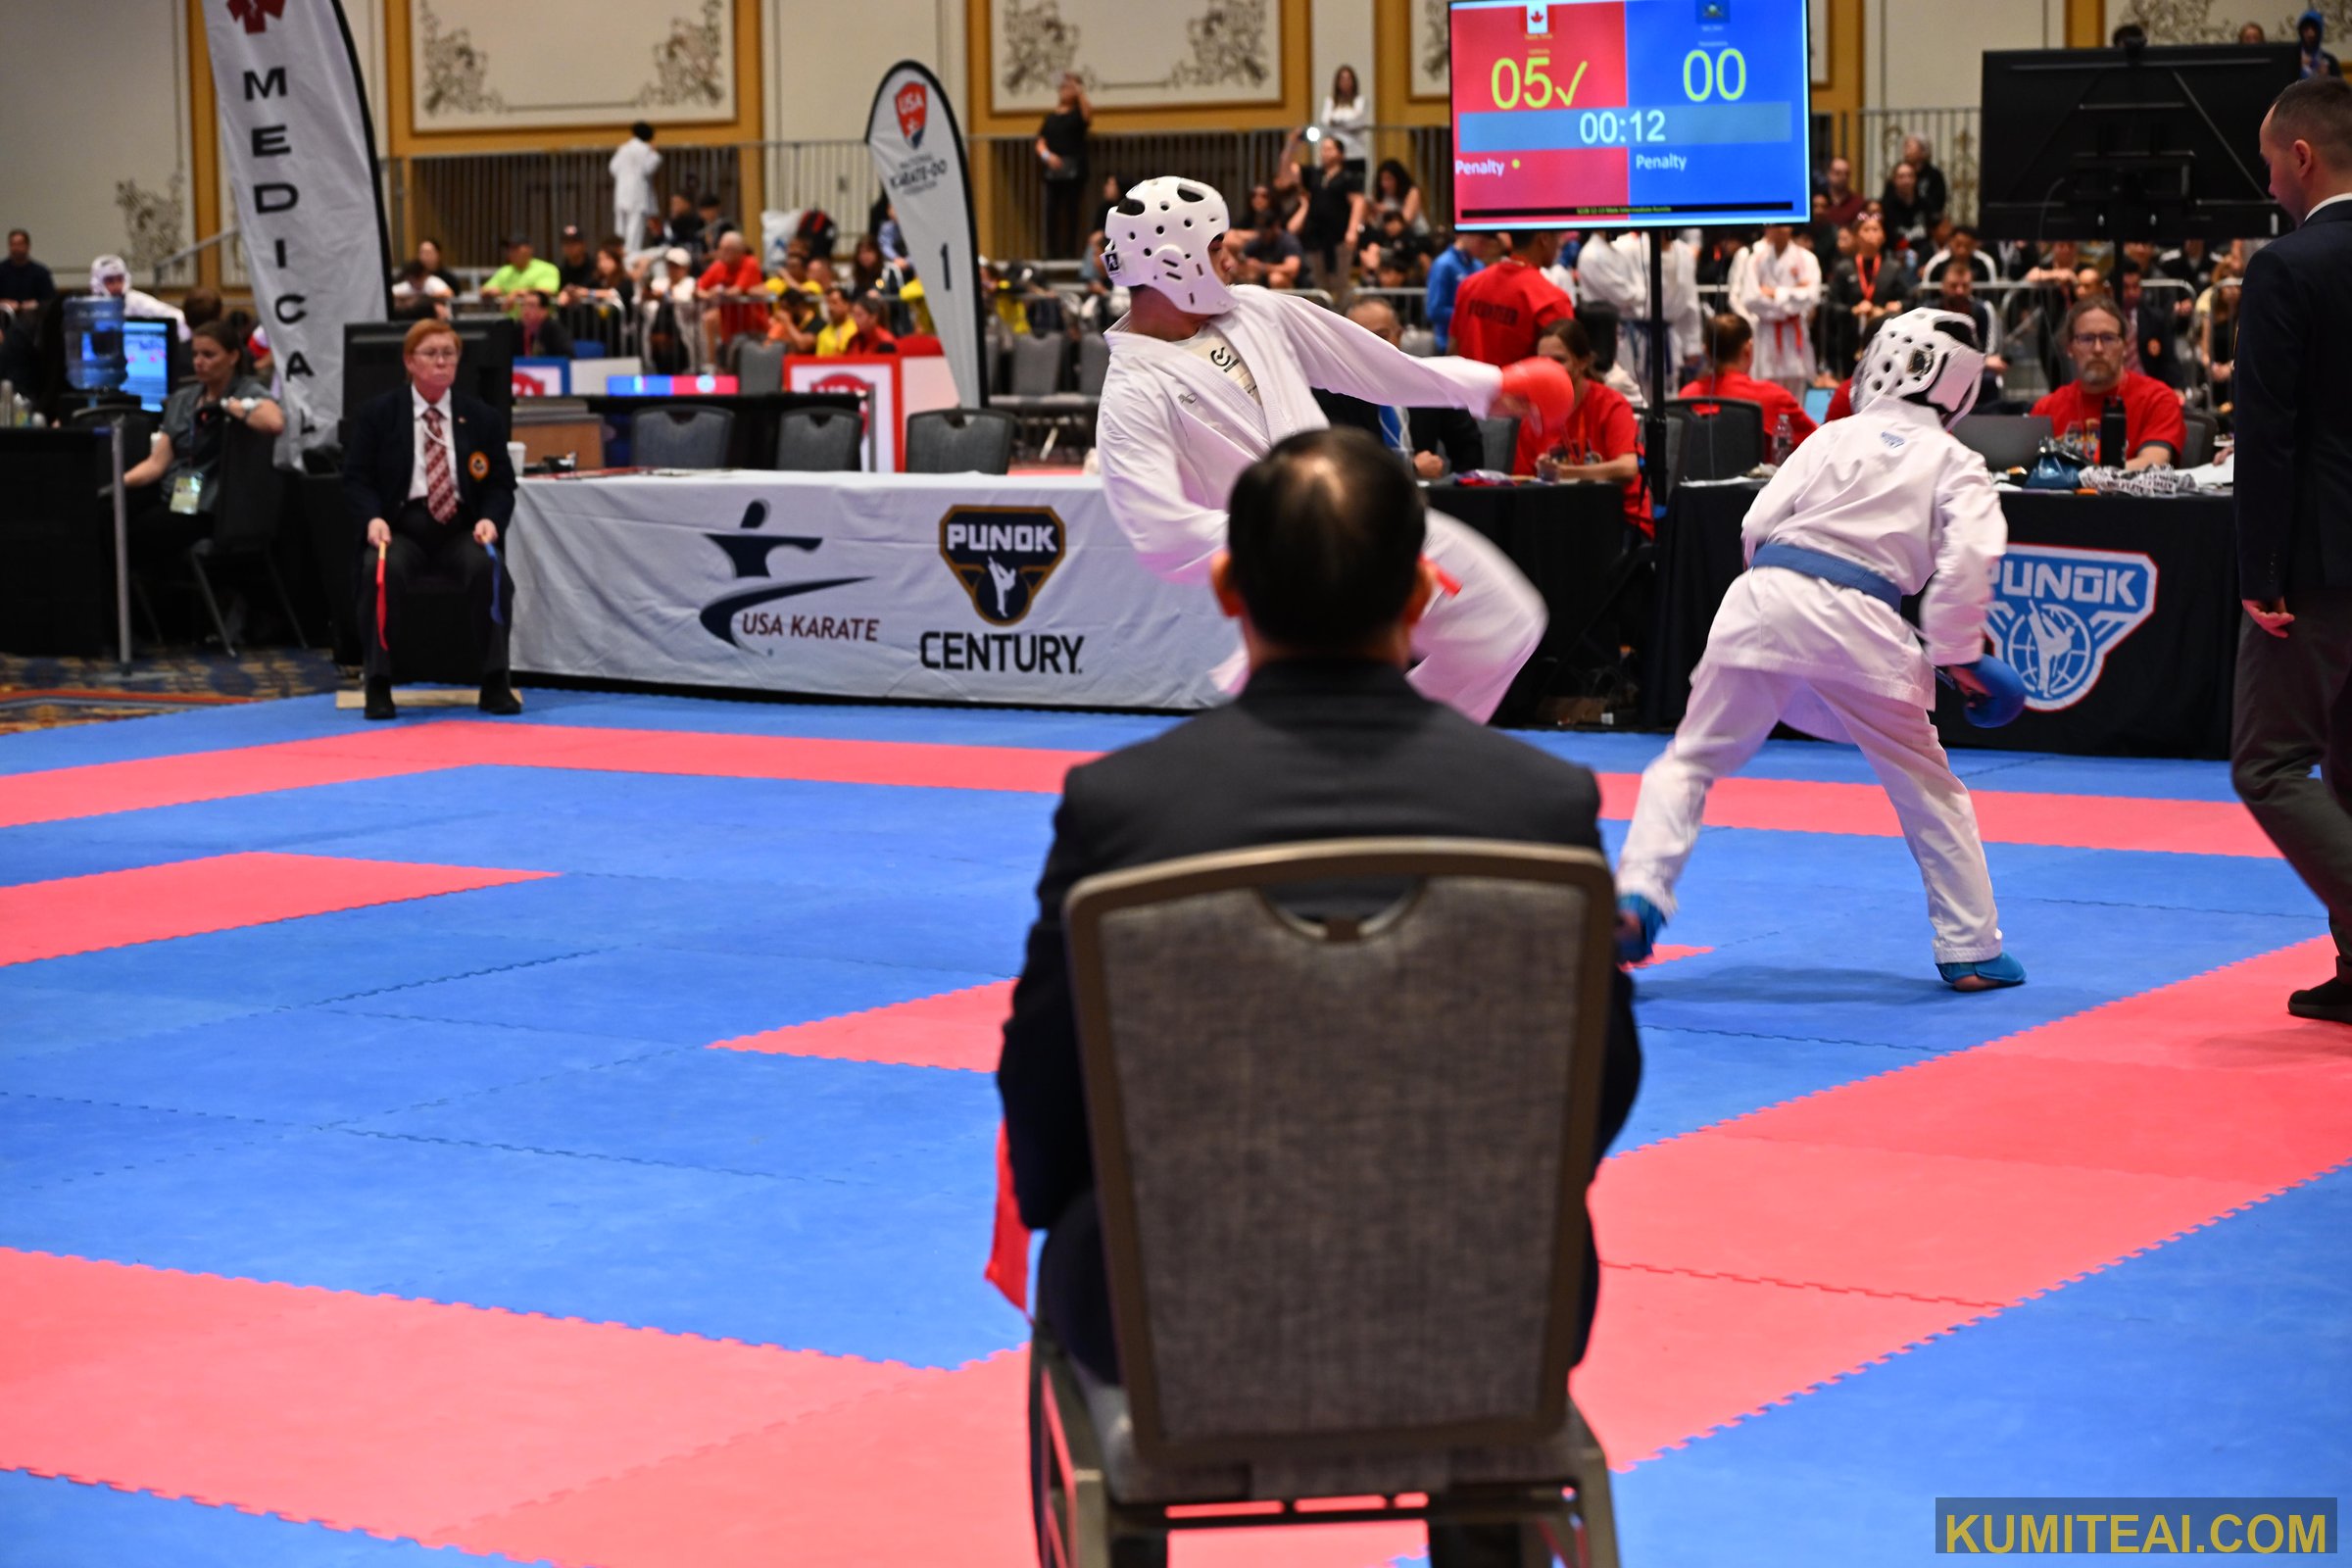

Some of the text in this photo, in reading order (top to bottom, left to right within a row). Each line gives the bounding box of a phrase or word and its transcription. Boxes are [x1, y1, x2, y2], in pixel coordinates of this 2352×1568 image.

[1491, 57, 1553, 109] 05
[1683, 48, 1746, 101] 00
[898, 91, 924, 116] USA
[1580, 109, 1667, 144] 00:12
[1454, 159, 1505, 176] Penalty
[1636, 153, 1687, 171] Penalty
[242, 67, 318, 435] MEDICAL
[939, 242, 952, 291] 1
[947, 523, 1057, 553] PUNOK
[742, 612, 880, 642] USA KARATE
